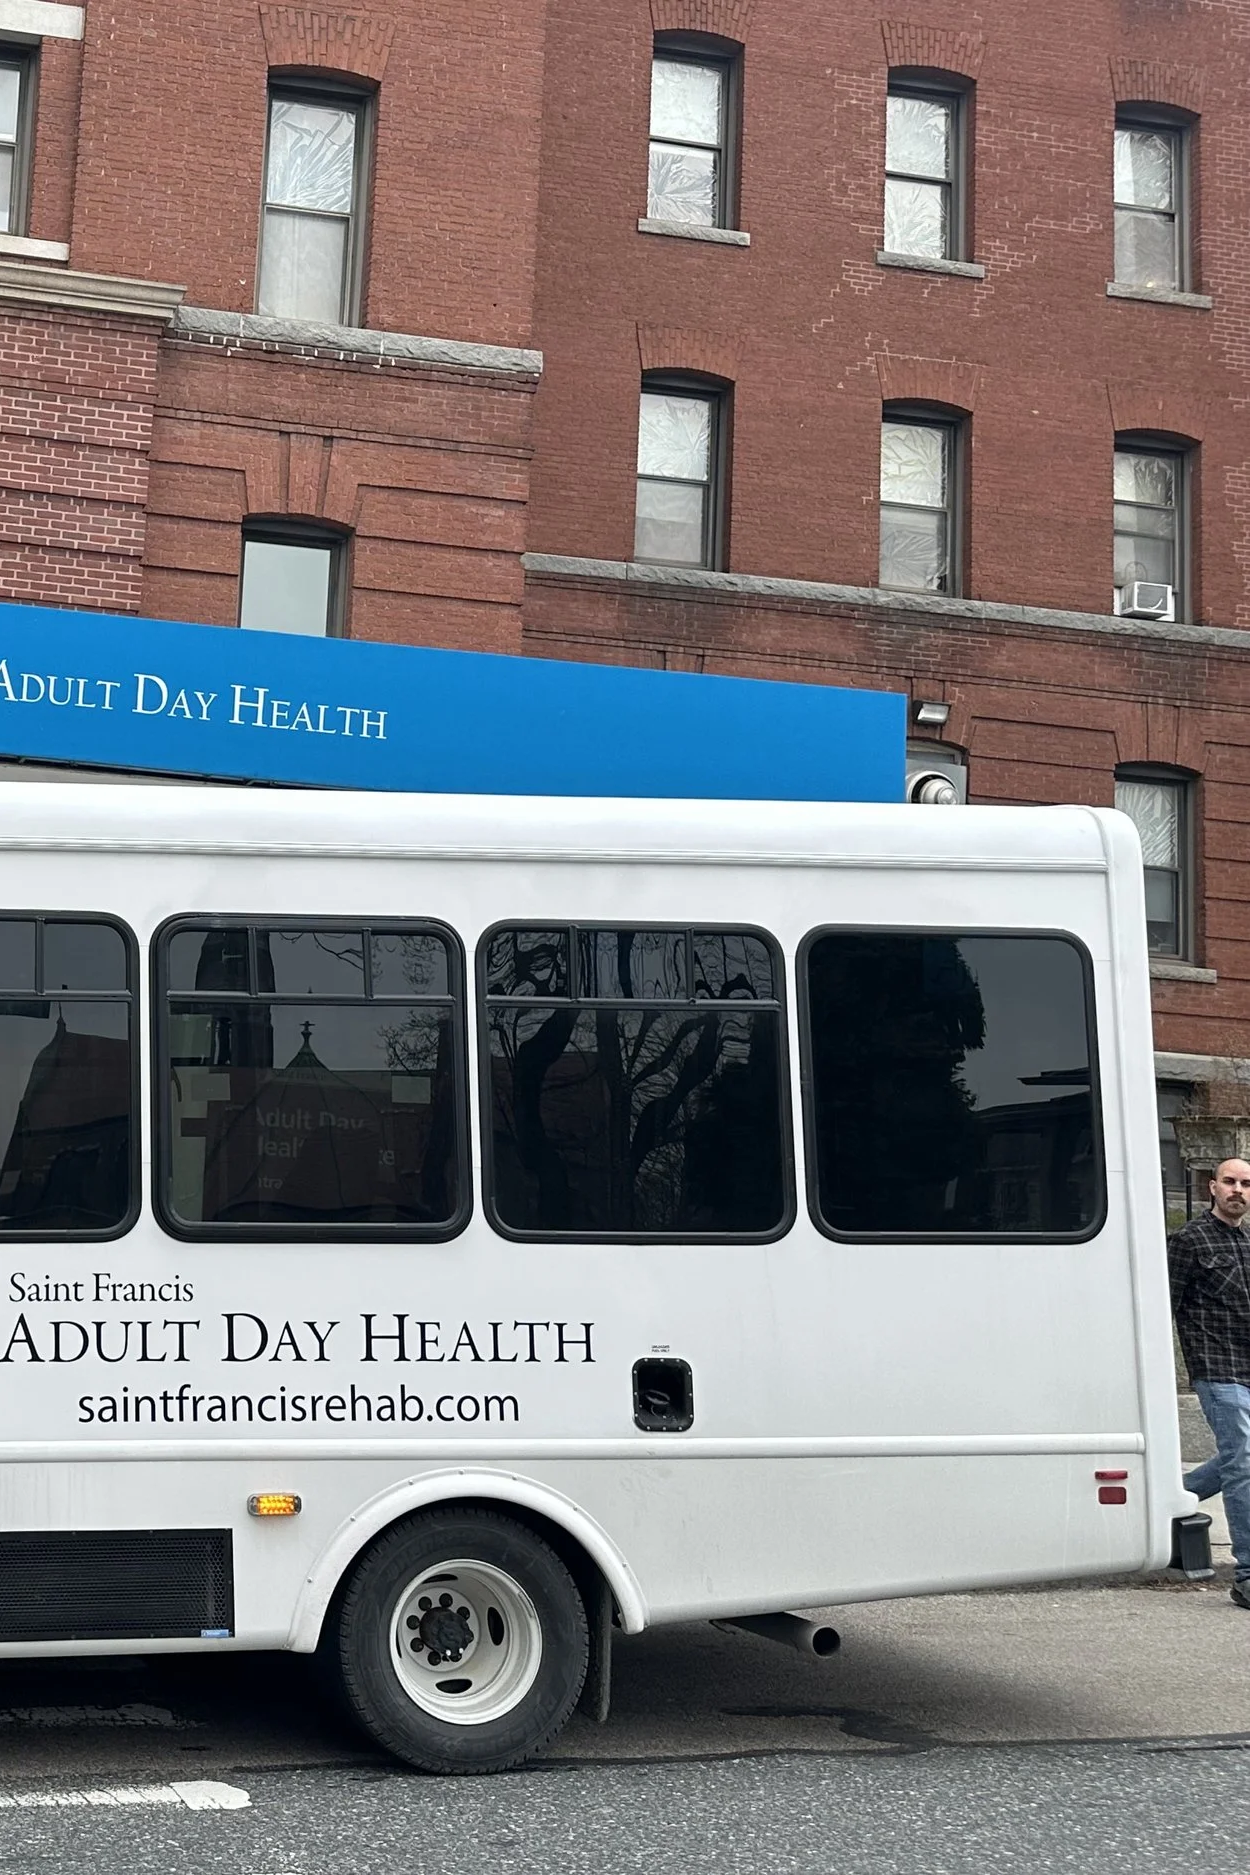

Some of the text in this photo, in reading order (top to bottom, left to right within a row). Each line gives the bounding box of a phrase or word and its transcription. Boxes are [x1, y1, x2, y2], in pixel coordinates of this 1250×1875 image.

[132, 673, 218, 721] DAY
[228, 684, 388, 740] HEALTH
[8, 1272, 194, 1303] Saint Francis
[220, 1312, 341, 1363] DAY
[359, 1313, 597, 1363] HEALTH
[78, 1383, 520, 1423] saintfrancisrehab.com
